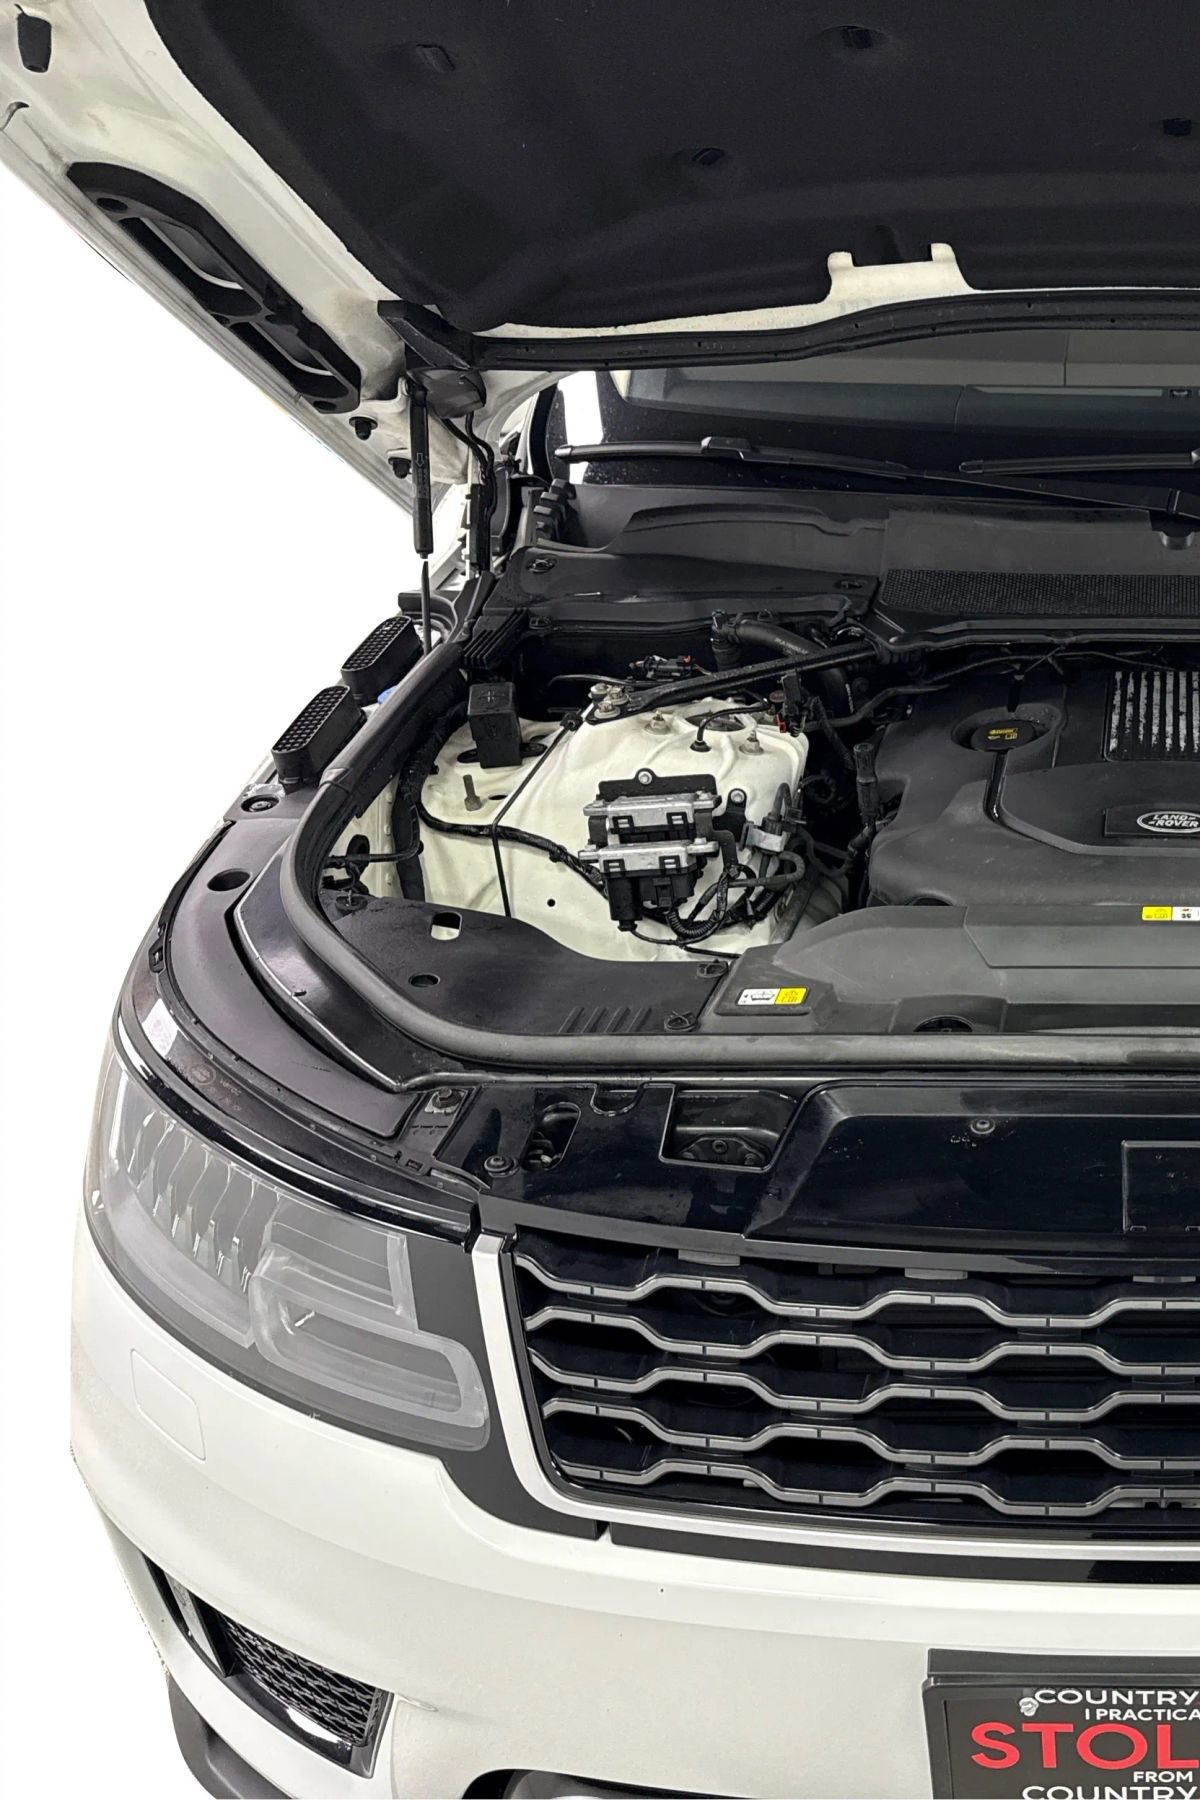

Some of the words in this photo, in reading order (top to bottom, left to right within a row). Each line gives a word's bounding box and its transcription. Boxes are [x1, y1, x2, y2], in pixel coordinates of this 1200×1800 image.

[1155, 819, 1199, 828] ROVER
[1085, 1708, 1090, 1720] I
[1133, 1771, 1193, 1783] FROM
